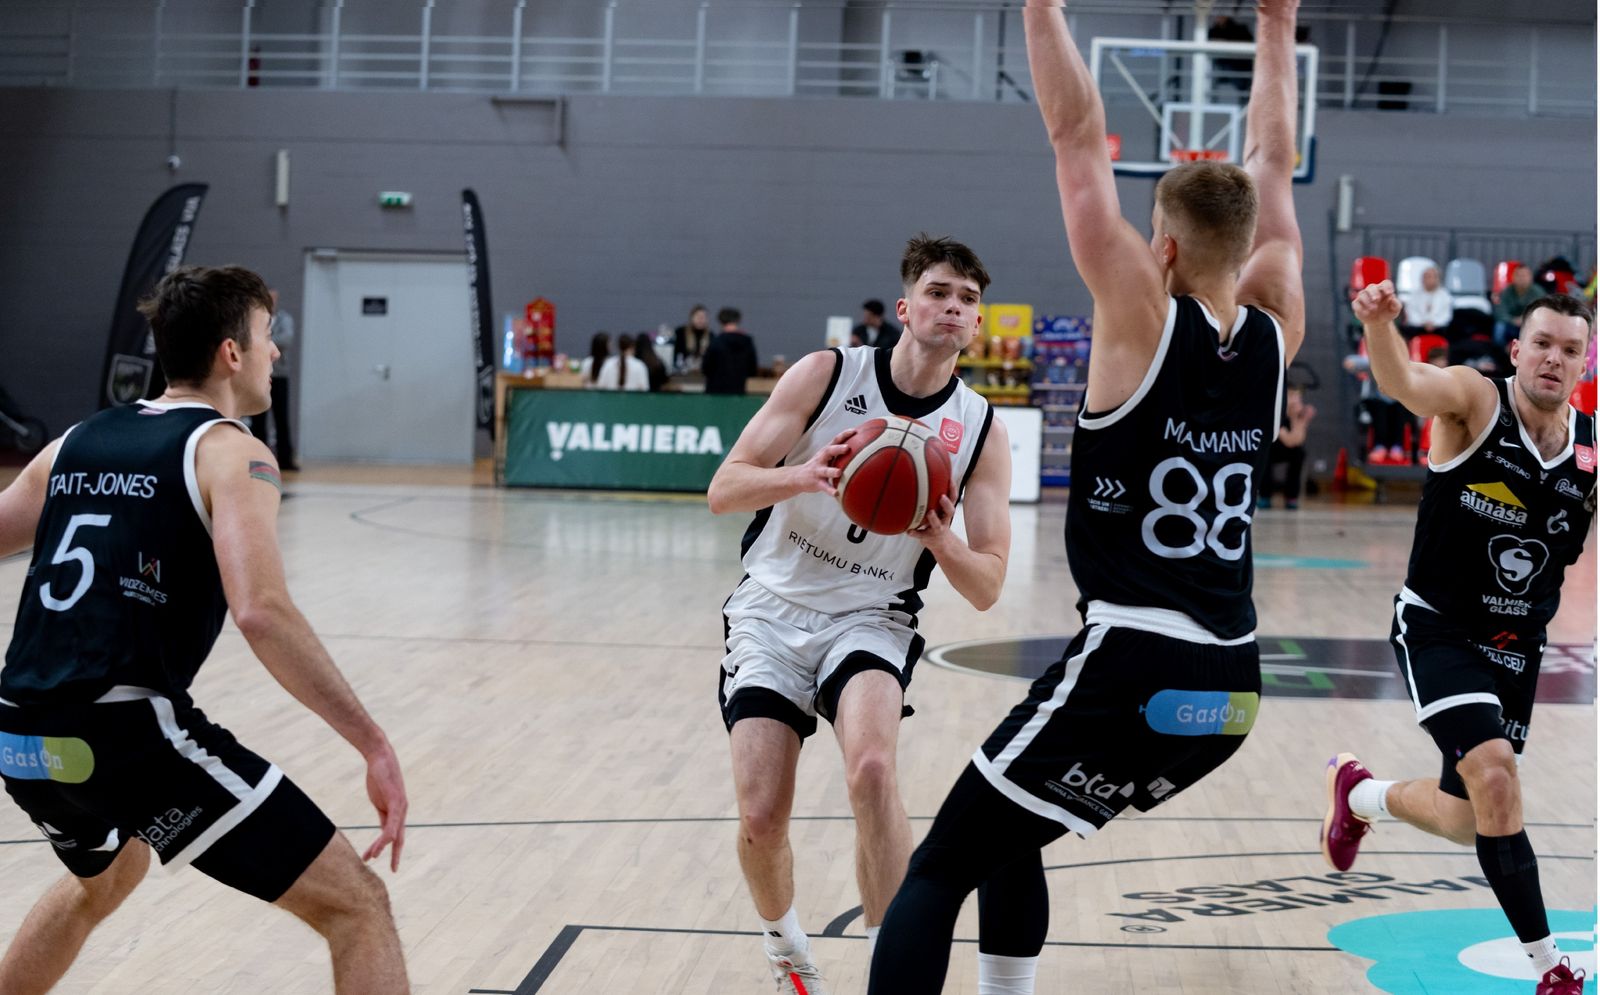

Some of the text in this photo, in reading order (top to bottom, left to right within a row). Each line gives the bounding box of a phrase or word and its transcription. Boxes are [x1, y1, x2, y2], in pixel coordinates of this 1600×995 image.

[547, 422, 723, 460] VALMIERA
[50, 472, 157, 498] TAIT-JONES
[1141, 456, 1254, 561] 88
[39, 514, 112, 612] 5
[788, 530, 848, 570] RIETUMU
[850, 563, 895, 581] BNK
[119, 576, 168, 604] VIDZEMES
[1490, 606, 1528, 616] GLASS
[1177, 702, 1245, 723] GasOn
[2, 747, 64, 770] GasOn
[1061, 762, 1120, 799] bta
[1122, 872, 1396, 903] GLASS
